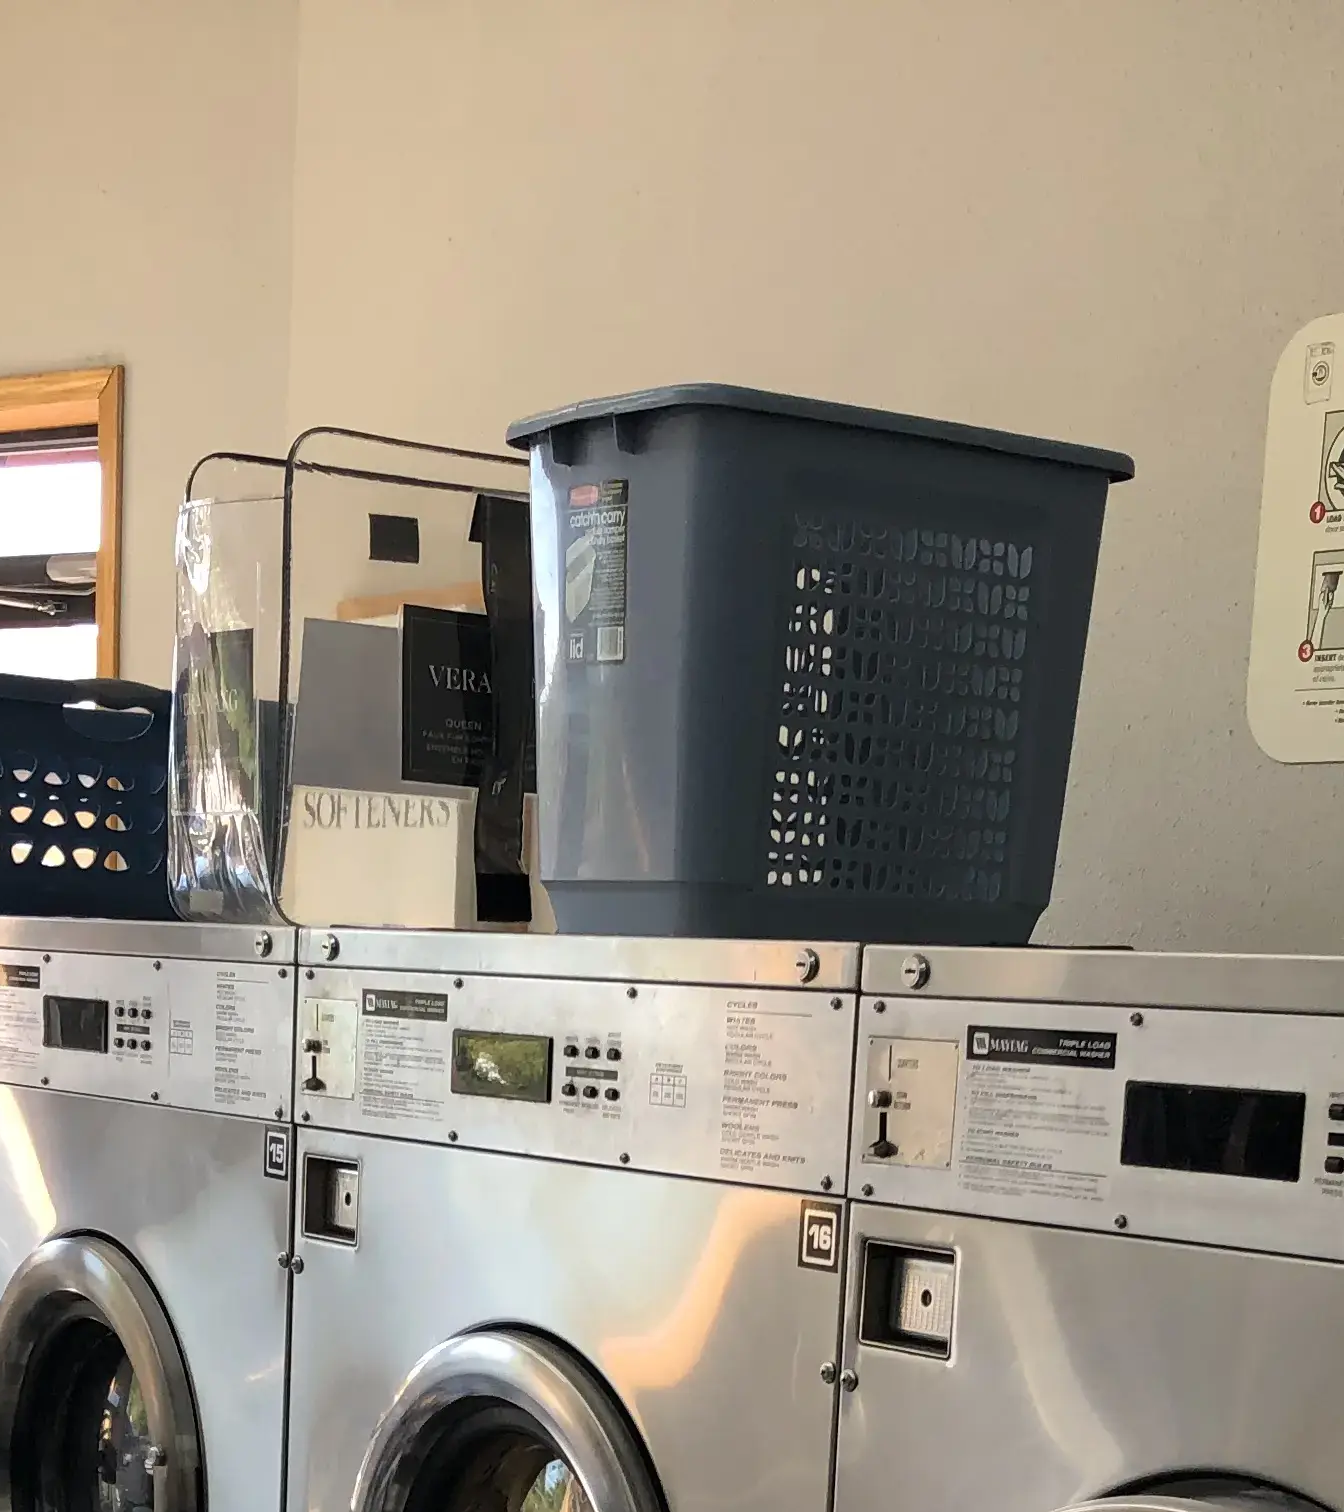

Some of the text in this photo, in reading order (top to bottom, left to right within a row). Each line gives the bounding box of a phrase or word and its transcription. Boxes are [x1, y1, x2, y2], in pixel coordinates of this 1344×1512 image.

[601, 510, 626, 527] carry
[428, 664, 492, 694] VERA
[445, 718, 482, 731] QUEEN
[303, 791, 451, 829] SOFTENERS
[270, 1143, 284, 1164] 15
[809, 1224, 831, 1251] 16
